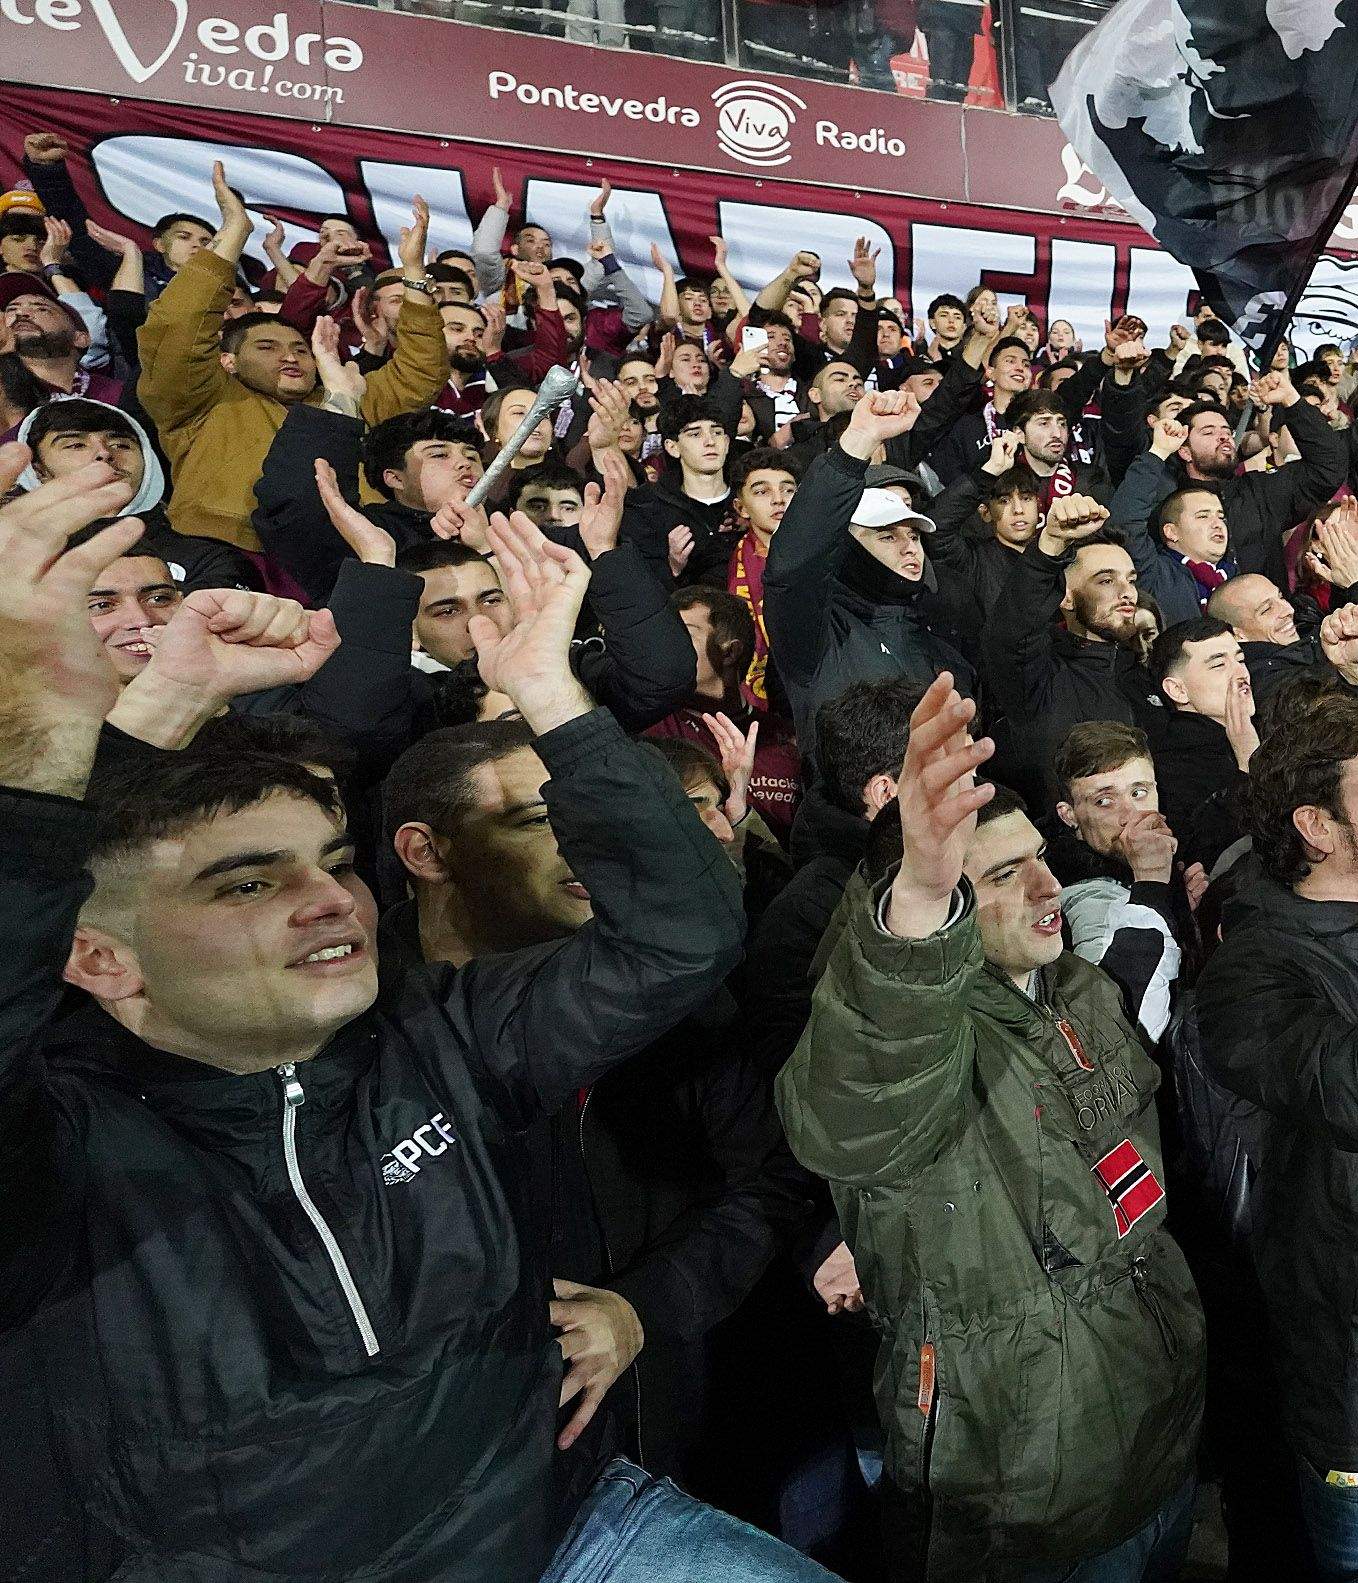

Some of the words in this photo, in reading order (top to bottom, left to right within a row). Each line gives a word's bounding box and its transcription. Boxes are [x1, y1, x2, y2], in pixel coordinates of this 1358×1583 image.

[488, 71, 700, 128] Pontevedra
[725, 108, 786, 140] Viva
[816, 120, 906, 157] Radio
[391, 1112, 456, 1173] PCF
